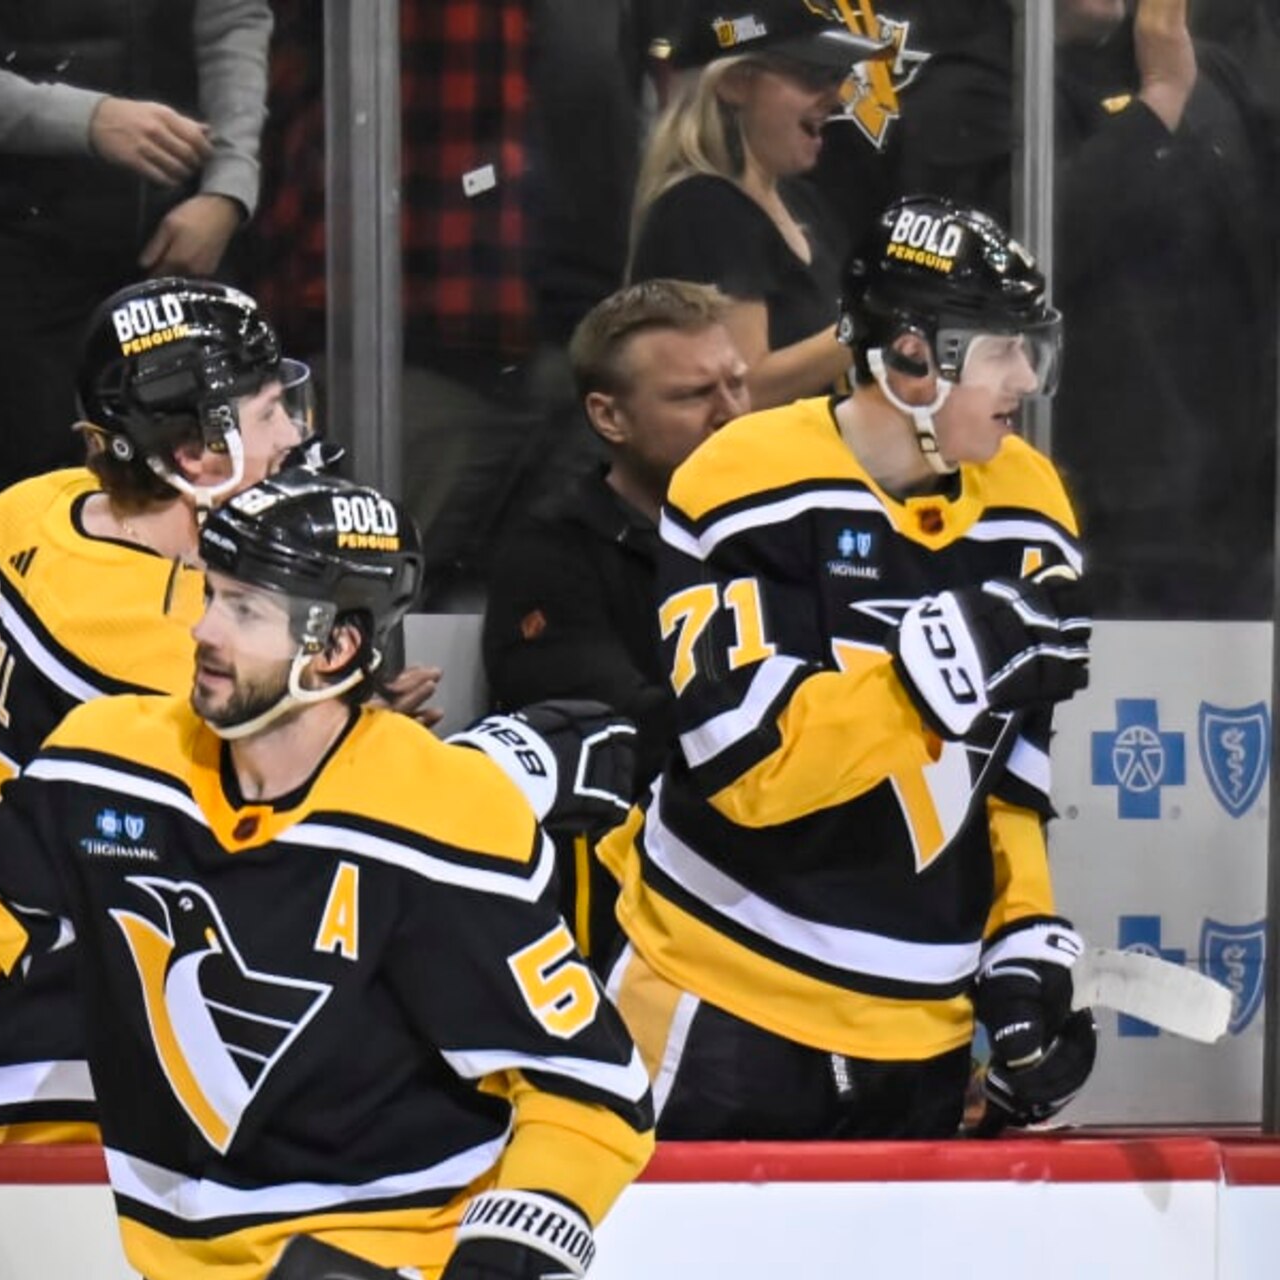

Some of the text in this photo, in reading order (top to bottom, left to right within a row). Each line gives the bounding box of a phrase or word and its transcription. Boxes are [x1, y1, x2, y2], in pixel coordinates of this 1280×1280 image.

[892, 208, 962, 256] BOLD
[887, 243, 953, 273] PENGUIN
[113, 293, 185, 343] BOLD
[332, 496, 399, 536] BOLD
[336, 532, 400, 551] PENGUIN
[658, 577, 777, 698] 71
[87, 840, 158, 861] HIGHMARK
[314, 860, 360, 961] A
